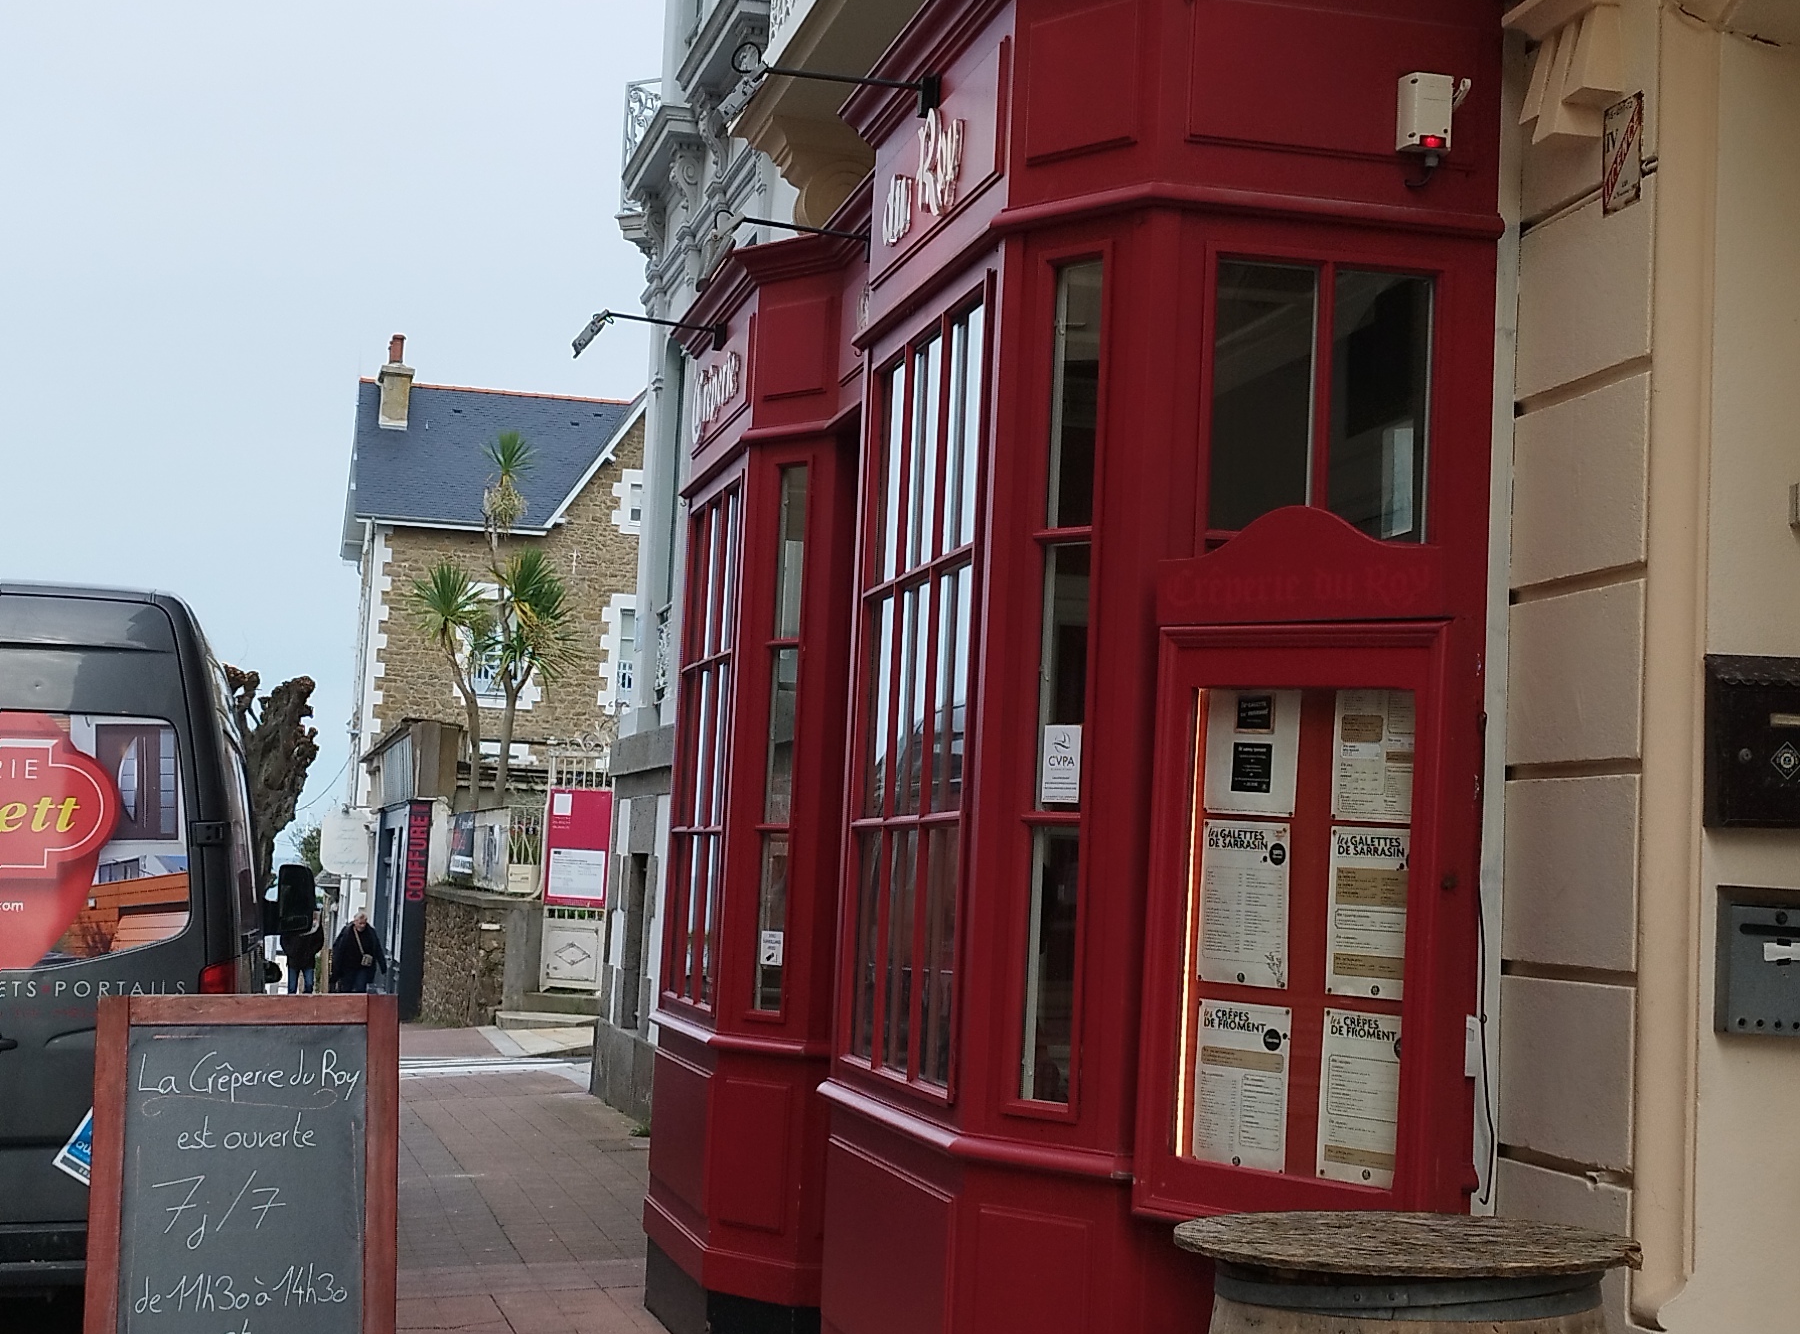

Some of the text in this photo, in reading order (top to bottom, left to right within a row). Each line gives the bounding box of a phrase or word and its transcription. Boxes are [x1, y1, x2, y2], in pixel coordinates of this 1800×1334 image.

[1048, 755, 1075, 767] CVPA
[1220, 829, 1265, 840] GALETTES
[1350, 835, 1401, 847] GALETTES
[1208, 838, 1268, 851] DE SARRASIN
[1337, 845, 1405, 857] DE SARRASIN
[406, 815, 430, 901] COIFFURE
[1203, 1017, 1266, 1033] DE FROMENT
[1330, 1025, 1397, 1042] DE FROMENT
[137, 1049, 362, 1103] La Crêperie du Roy
[177, 1112, 317, 1150] est ouverte
[135, 1275, 163, 1315] de
